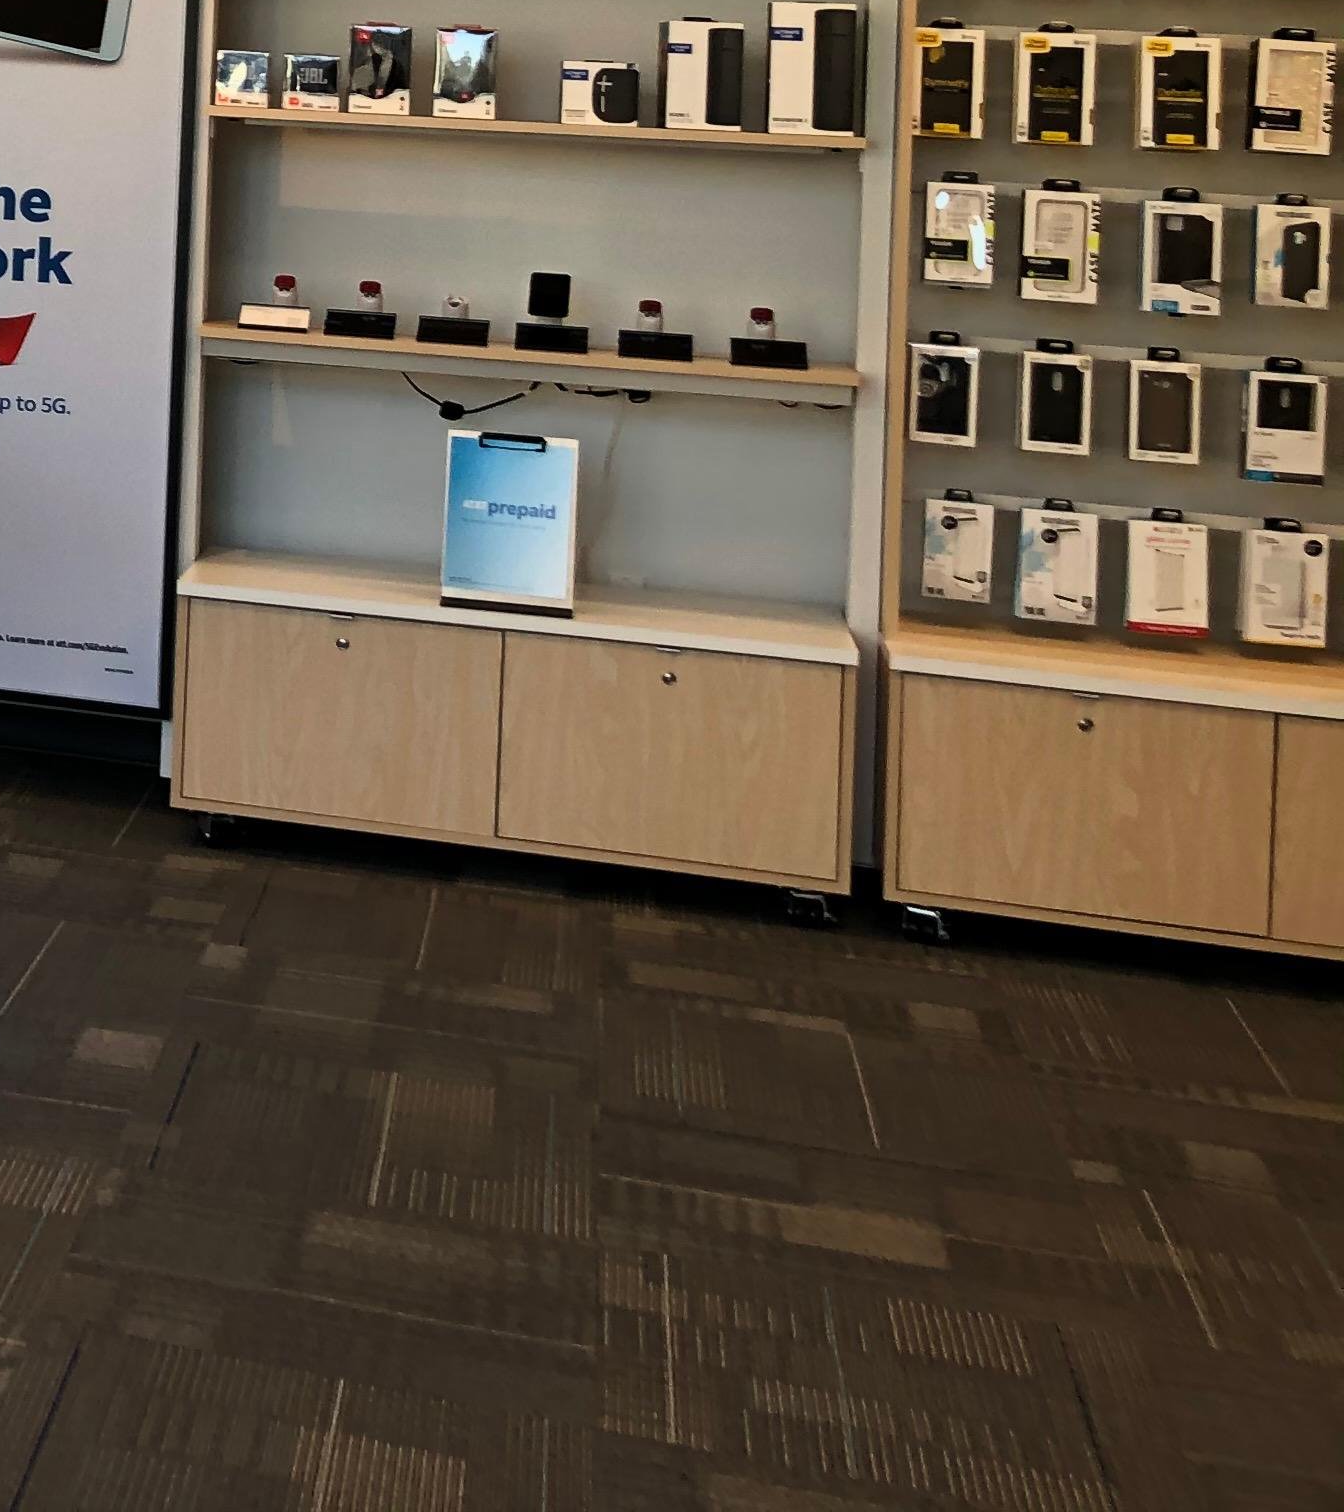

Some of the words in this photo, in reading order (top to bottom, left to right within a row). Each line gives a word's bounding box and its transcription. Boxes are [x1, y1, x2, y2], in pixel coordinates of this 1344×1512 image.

[299, 67, 329, 85] JBL
[15, 395, 38, 413] to
[41, 397, 71, 415] 5G.
[487, 501, 556, 520] prepaid
